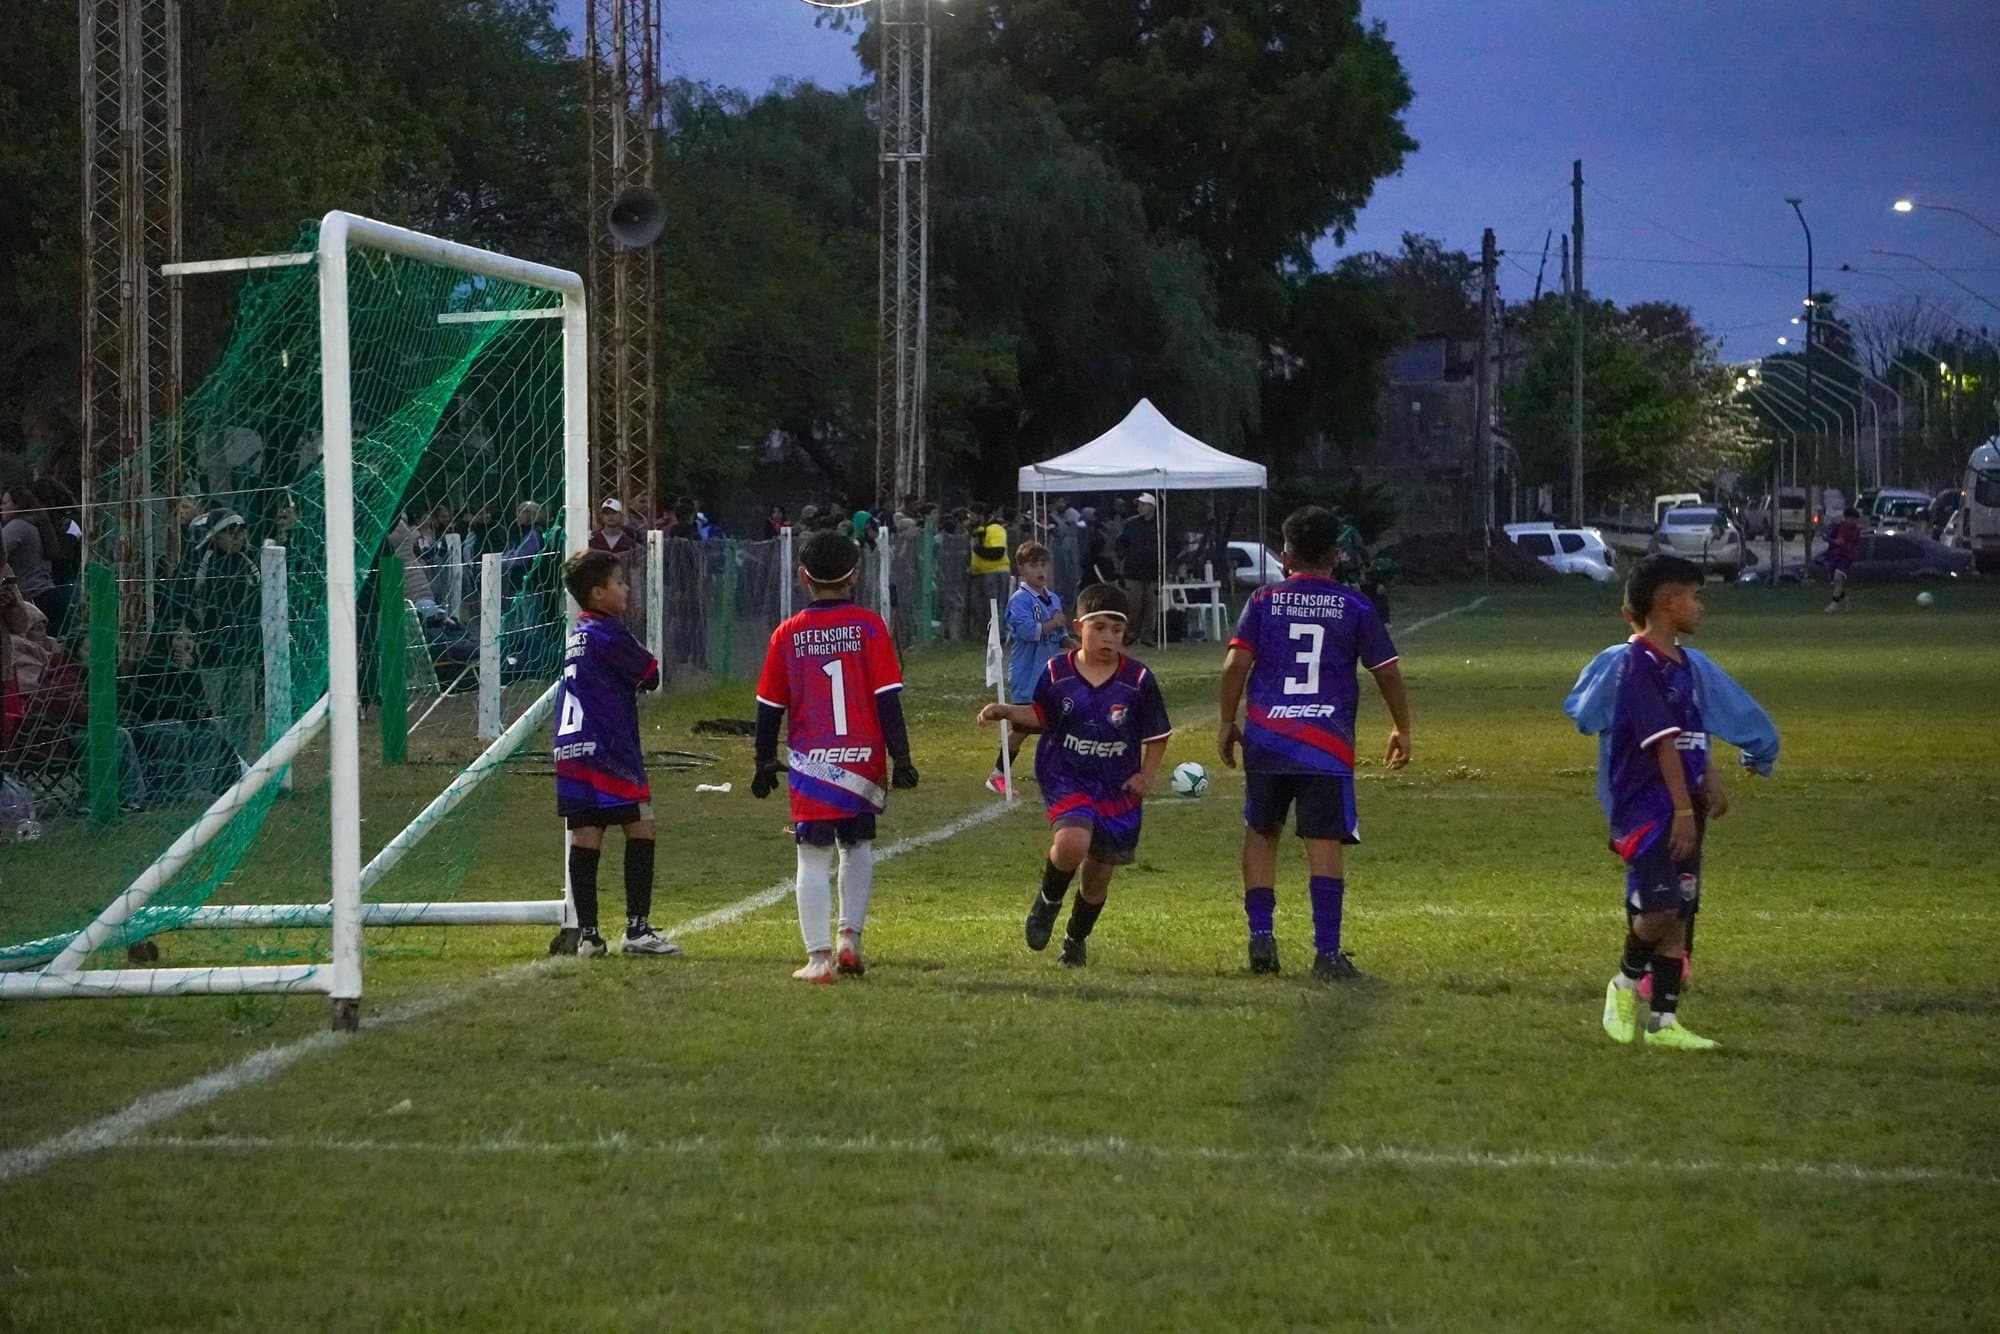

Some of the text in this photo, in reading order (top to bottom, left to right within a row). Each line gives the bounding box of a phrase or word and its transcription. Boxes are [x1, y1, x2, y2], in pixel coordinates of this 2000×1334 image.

[1272, 592, 1345, 609] DEFENSORES
[1271, 605, 1344, 620] DE ARGENTINOS
[793, 626, 861, 646] DEFENSORES
[795, 646, 806, 659] DE
[1283, 623, 1325, 695] 3
[822, 659, 848, 736] 1
[1267, 704, 1335, 719] MEIER
[1063, 733, 1128, 758] MEIER
[807, 747, 872, 764] MEIER
